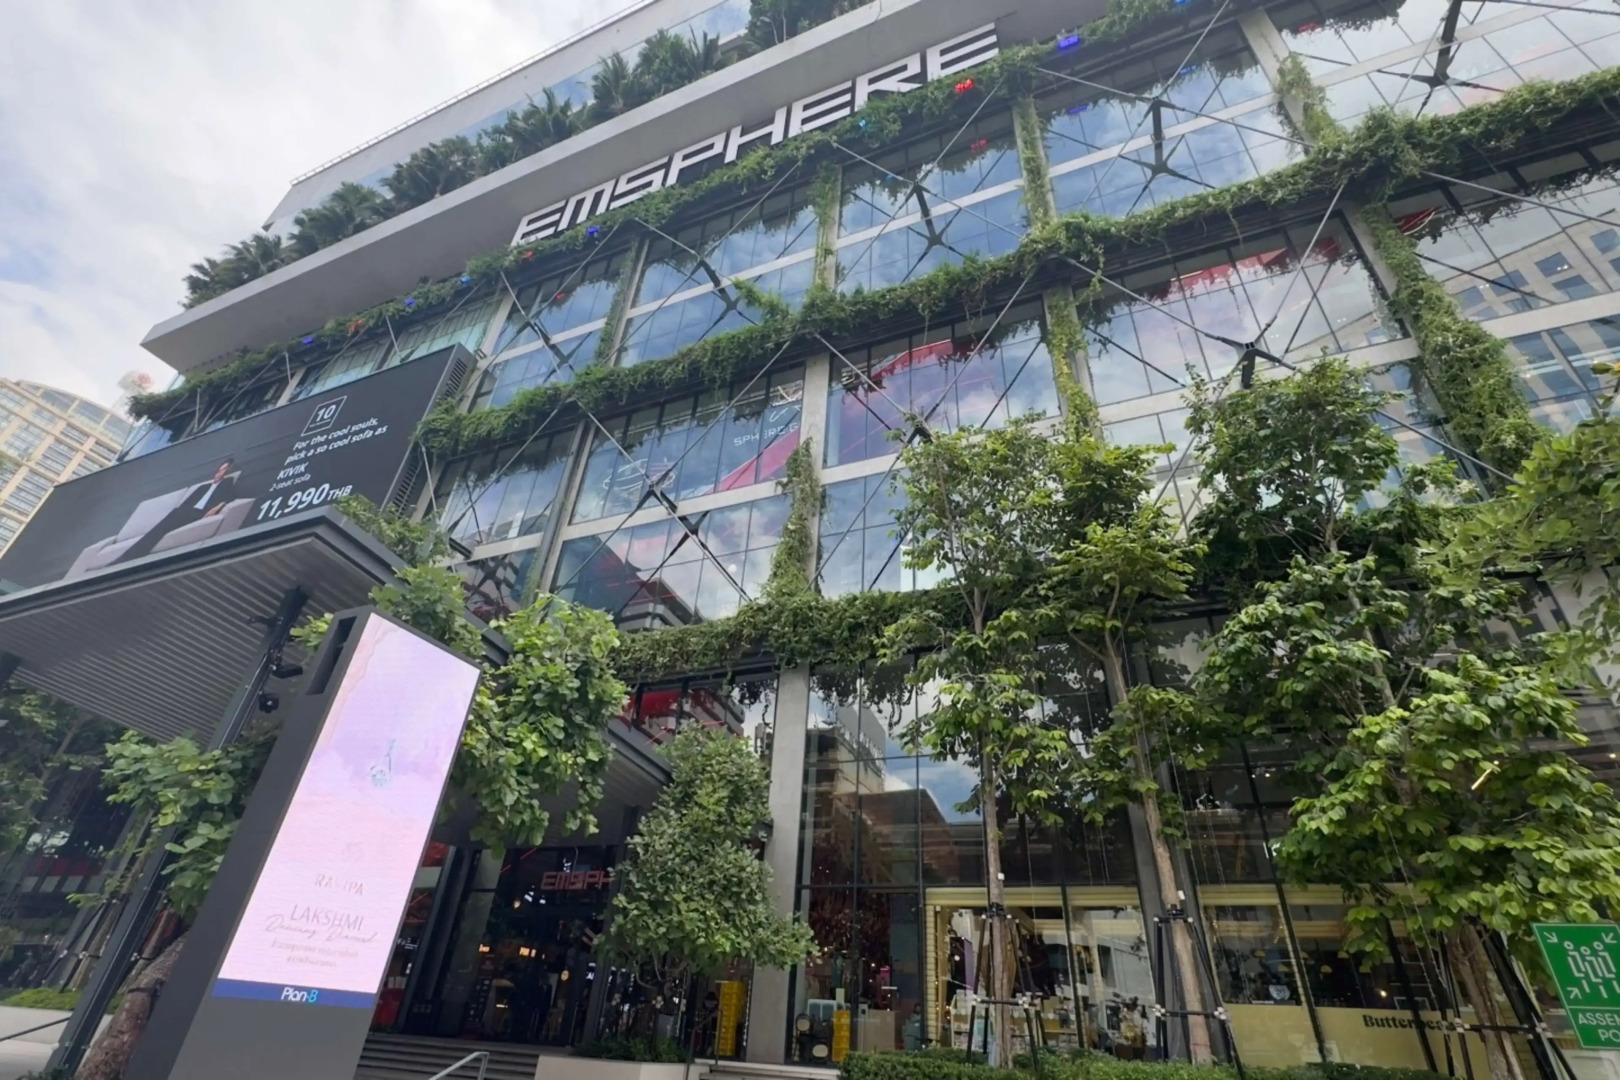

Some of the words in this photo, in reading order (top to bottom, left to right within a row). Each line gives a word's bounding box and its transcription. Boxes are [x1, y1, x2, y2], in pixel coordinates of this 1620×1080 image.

[511, 22, 999, 246] EMSPHERE
[315, 404, 337, 422] 10
[284, 450, 307, 466] pick
[306, 449, 314, 457] a
[316, 445, 327, 454] so
[328, 436, 351, 450] cool
[350, 429, 374, 443] sofa
[374, 425, 389, 435] as
[293, 440, 309, 451] For
[310, 433, 327, 445] the
[328, 425, 351, 440] cool
[276, 461, 310, 481] KIVIK
[294, 473, 312, 485] sofa
[256, 482, 331, 521] 11,990
[327, 484, 353, 501] THB
[290, 903, 365, 932] LAKSHMI
